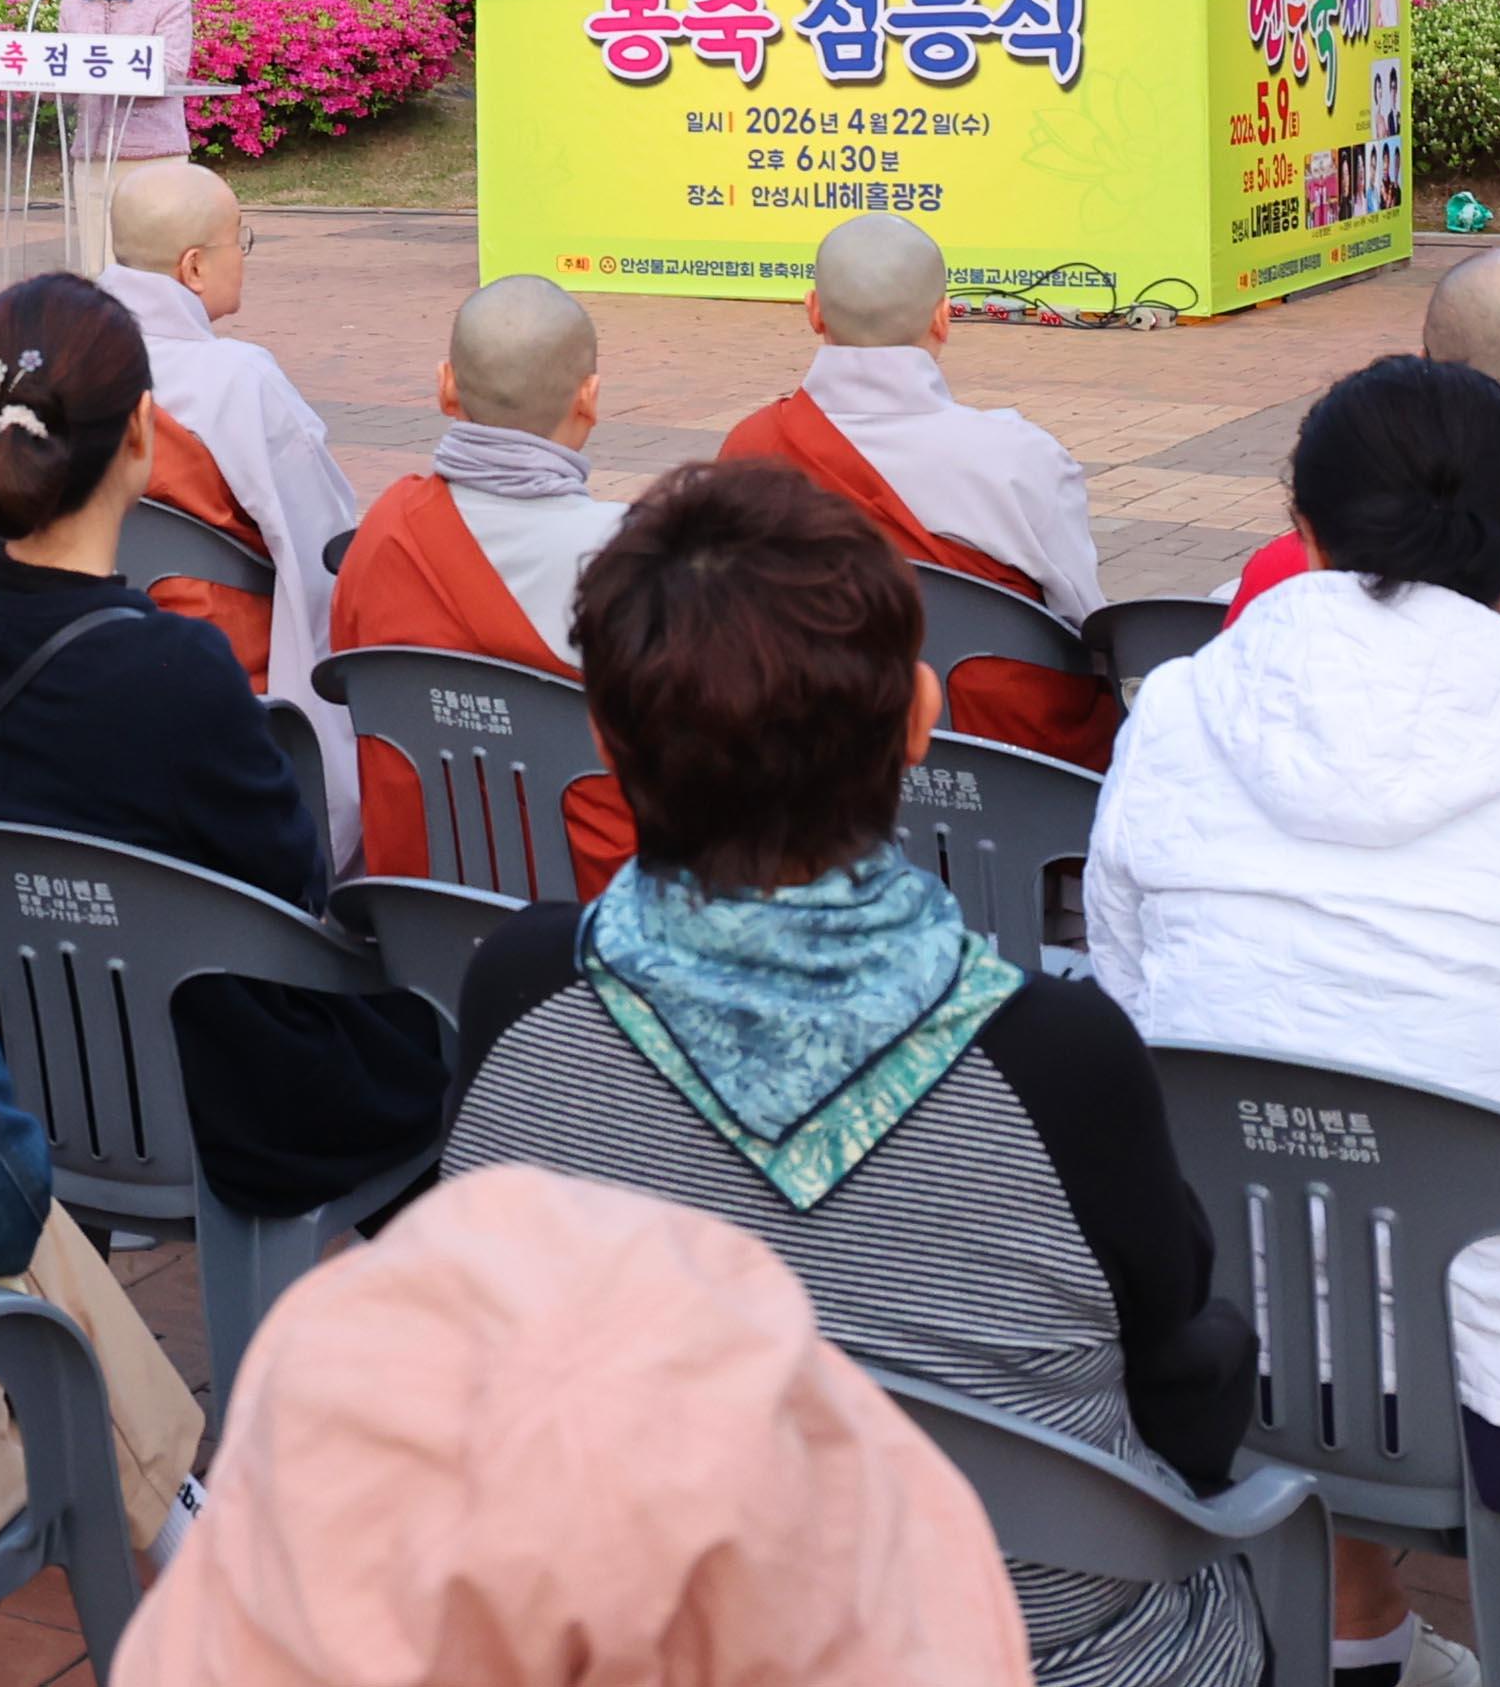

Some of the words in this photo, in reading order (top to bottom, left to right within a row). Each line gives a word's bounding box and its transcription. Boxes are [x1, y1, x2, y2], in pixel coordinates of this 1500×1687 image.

[686, 111, 724, 133] 일시
[747, 149, 786, 172] 오후
[687, 185, 725, 207] 장소
[751, 186, 809, 209] 안성시
[812, 181, 944, 212] 내혜홀광장
[1238, 1099, 1375, 1134] 으뜸이벤트
